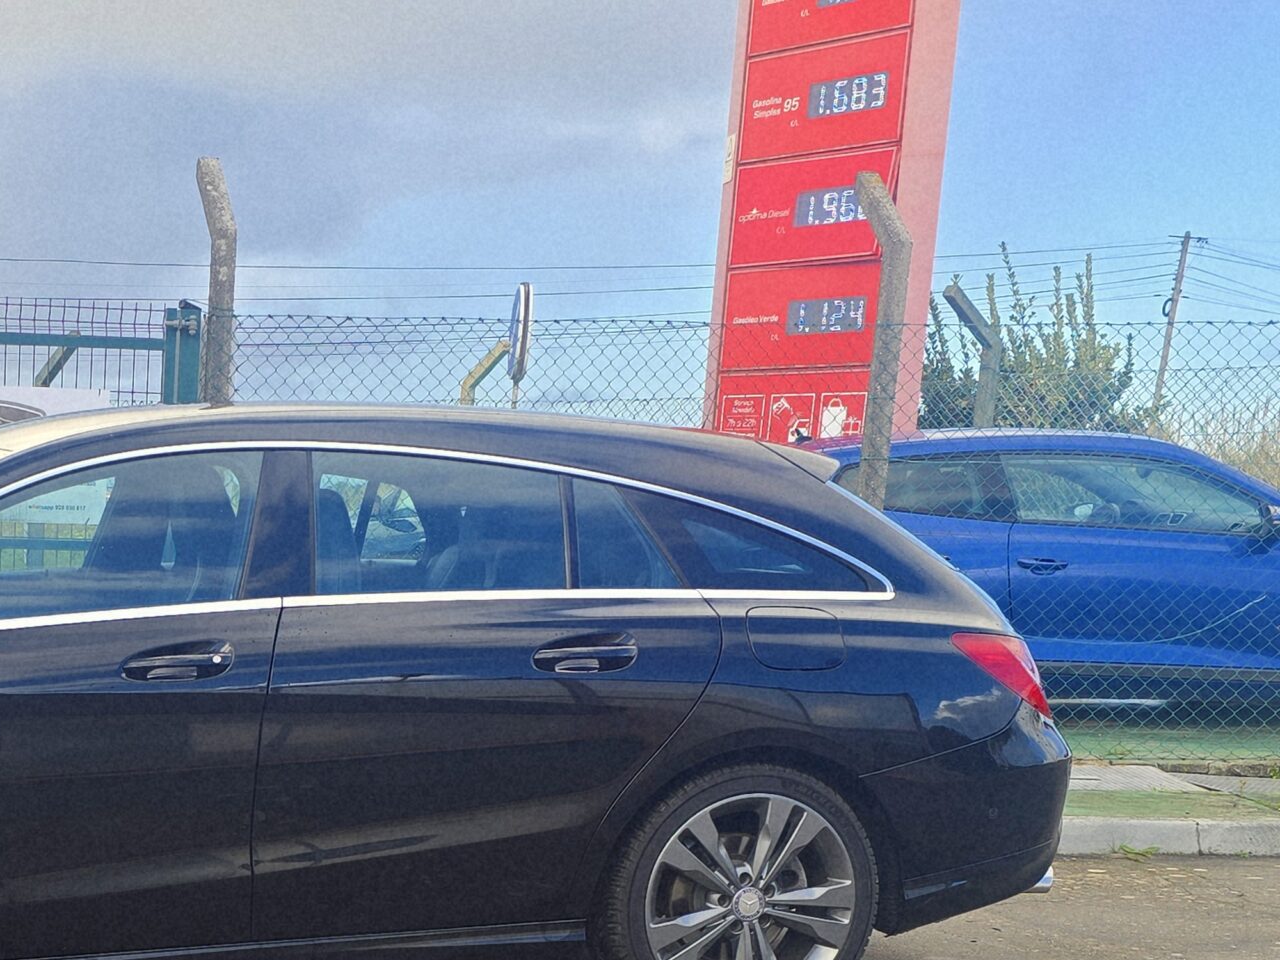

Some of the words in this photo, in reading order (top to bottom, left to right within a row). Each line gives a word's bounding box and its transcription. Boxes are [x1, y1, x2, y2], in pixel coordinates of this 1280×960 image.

[818, 73, 887, 115] 1.683
[752, 96, 782, 109] Gasolina
[783, 97, 801, 112] 95
[753, 107, 781, 119] Simples
[768, 208, 791, 219] Diesel
[759, 313, 779, 323] Verde
